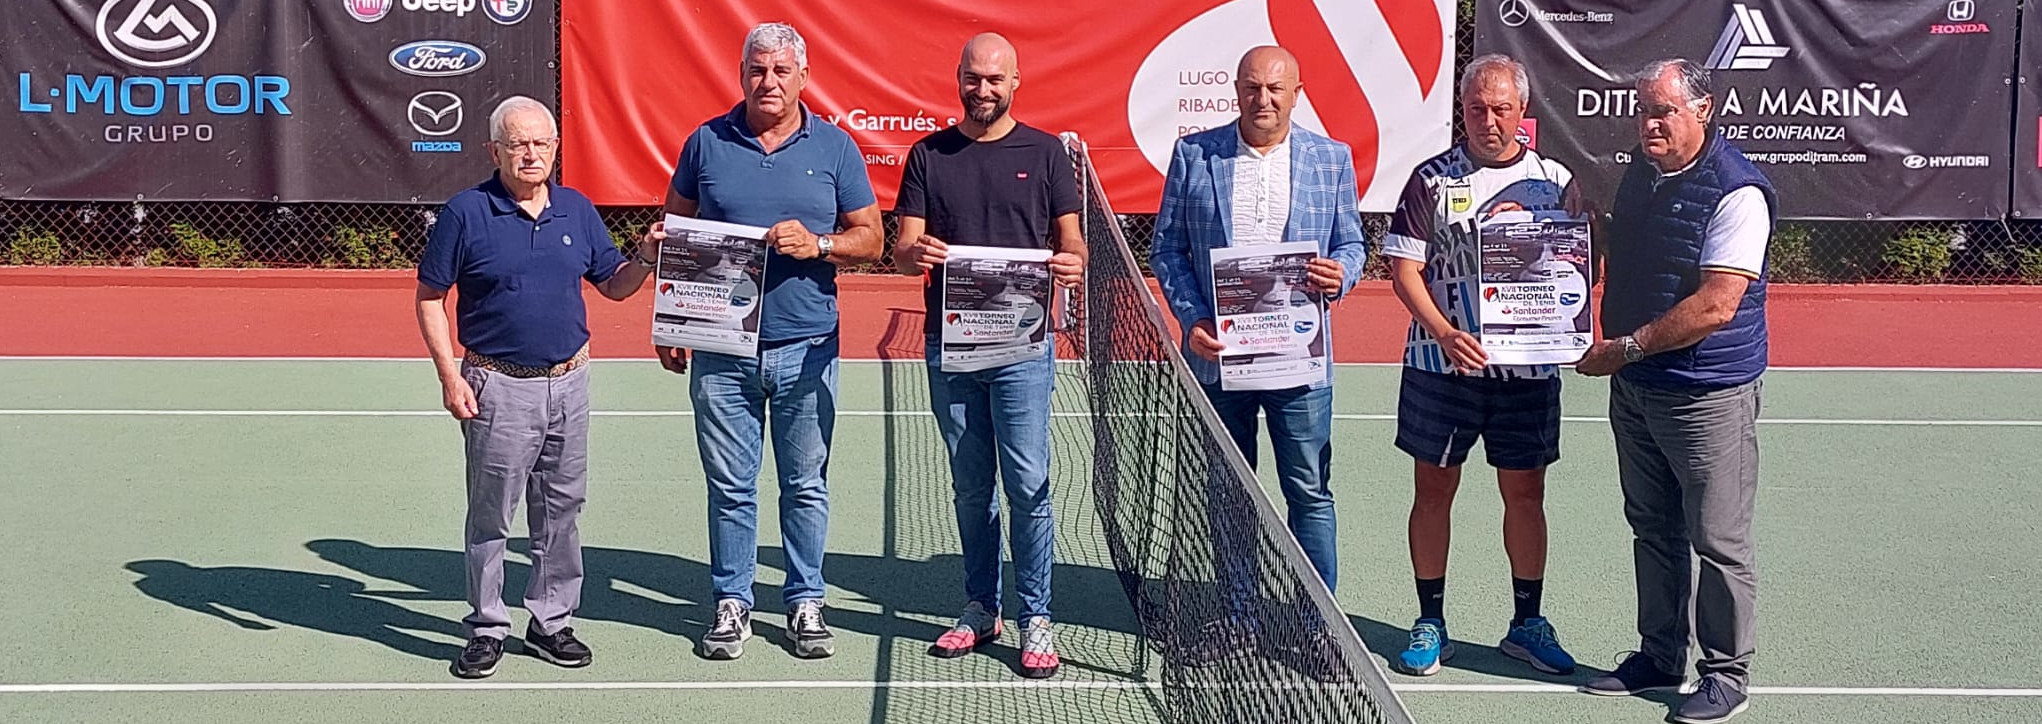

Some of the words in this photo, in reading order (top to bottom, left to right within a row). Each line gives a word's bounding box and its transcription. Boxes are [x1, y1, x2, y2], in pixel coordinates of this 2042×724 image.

[1535, 9, 1614, 23] Mercedes-Benz
[1930, 24, 1990, 34] HONDA
[408, 46, 466, 70] Ford
[1180, 71, 1229, 85] LUGO
[1178, 98, 1239, 112] RIBADE
[1720, 87, 1743, 117] A
[1758, 82, 1909, 117] MARIÑA
[104, 124, 214, 143] GRUPO
[1726, 126, 1749, 140] DE
[1752, 125, 1846, 142] CONFIANZA
[412, 141, 462, 152] mazda
[865, 154, 895, 166] SING
[1929, 156, 1989, 168] HYUNDAI
[693, 285, 729, 293] TORNEO
[676, 290, 729, 300] NACIONAL
[685, 303, 727, 312] Santander
[1512, 307, 1557, 315] Santander
[1252, 314, 1289, 322] TORNEO
[1237, 322, 1290, 331] NACIONAL
[1250, 336, 1290, 345] Santander
